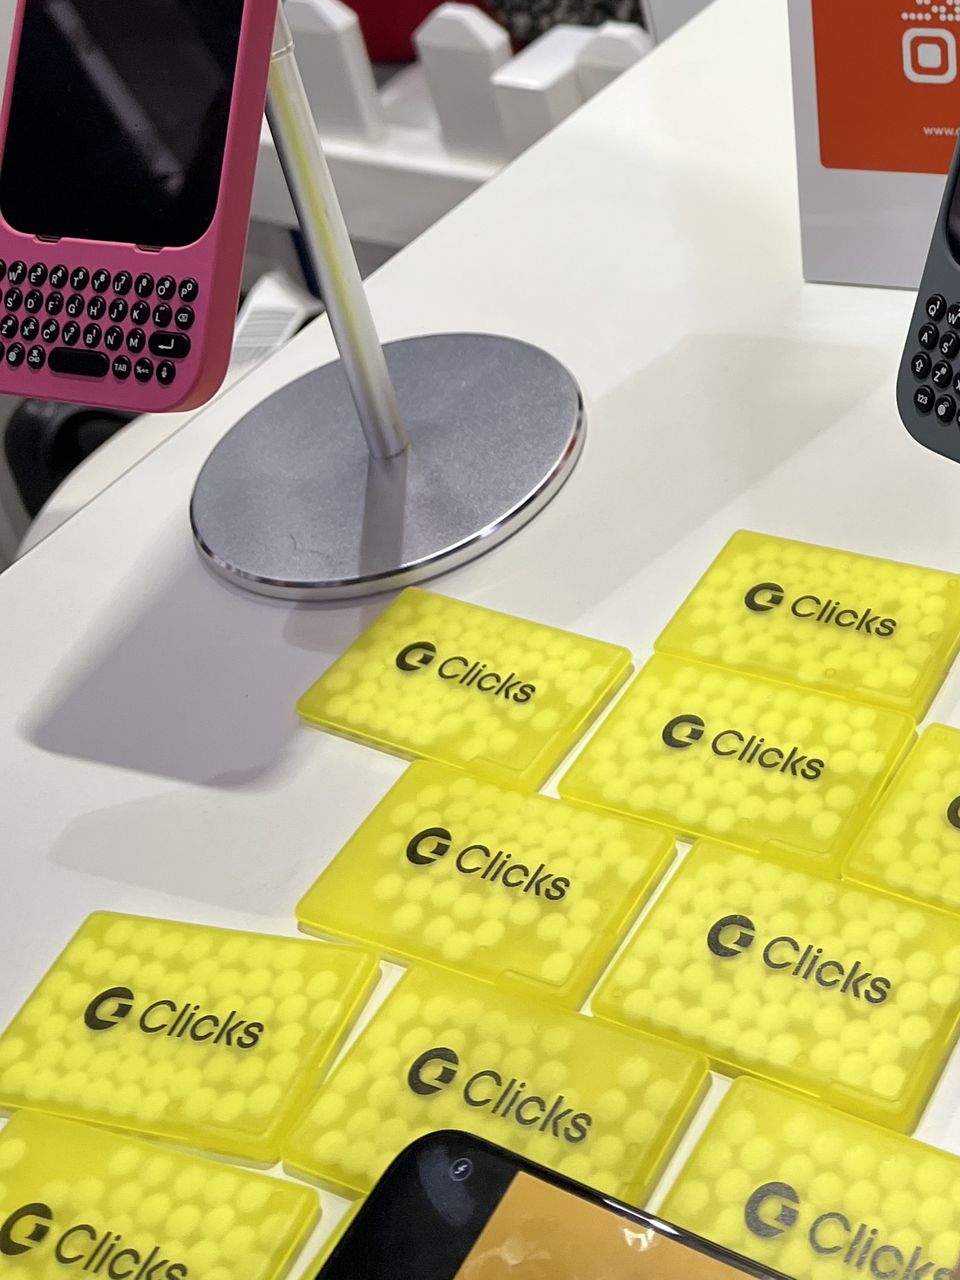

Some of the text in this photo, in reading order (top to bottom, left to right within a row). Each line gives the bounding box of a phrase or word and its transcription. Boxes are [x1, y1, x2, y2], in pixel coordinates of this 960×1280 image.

[114, 363, 126, 372] TAB
[917, 394, 928, 404] 123
[790, 594, 898, 638] Clicks
[437, 655, 537, 705] Clicks
[711, 729, 825, 781] Clicks
[455, 843, 571, 903] Clicks
[762, 935, 892, 1006] Clicks
[139, 999, 264, 1050] Clicks
[463, 1070, 593, 1144] Clicks
